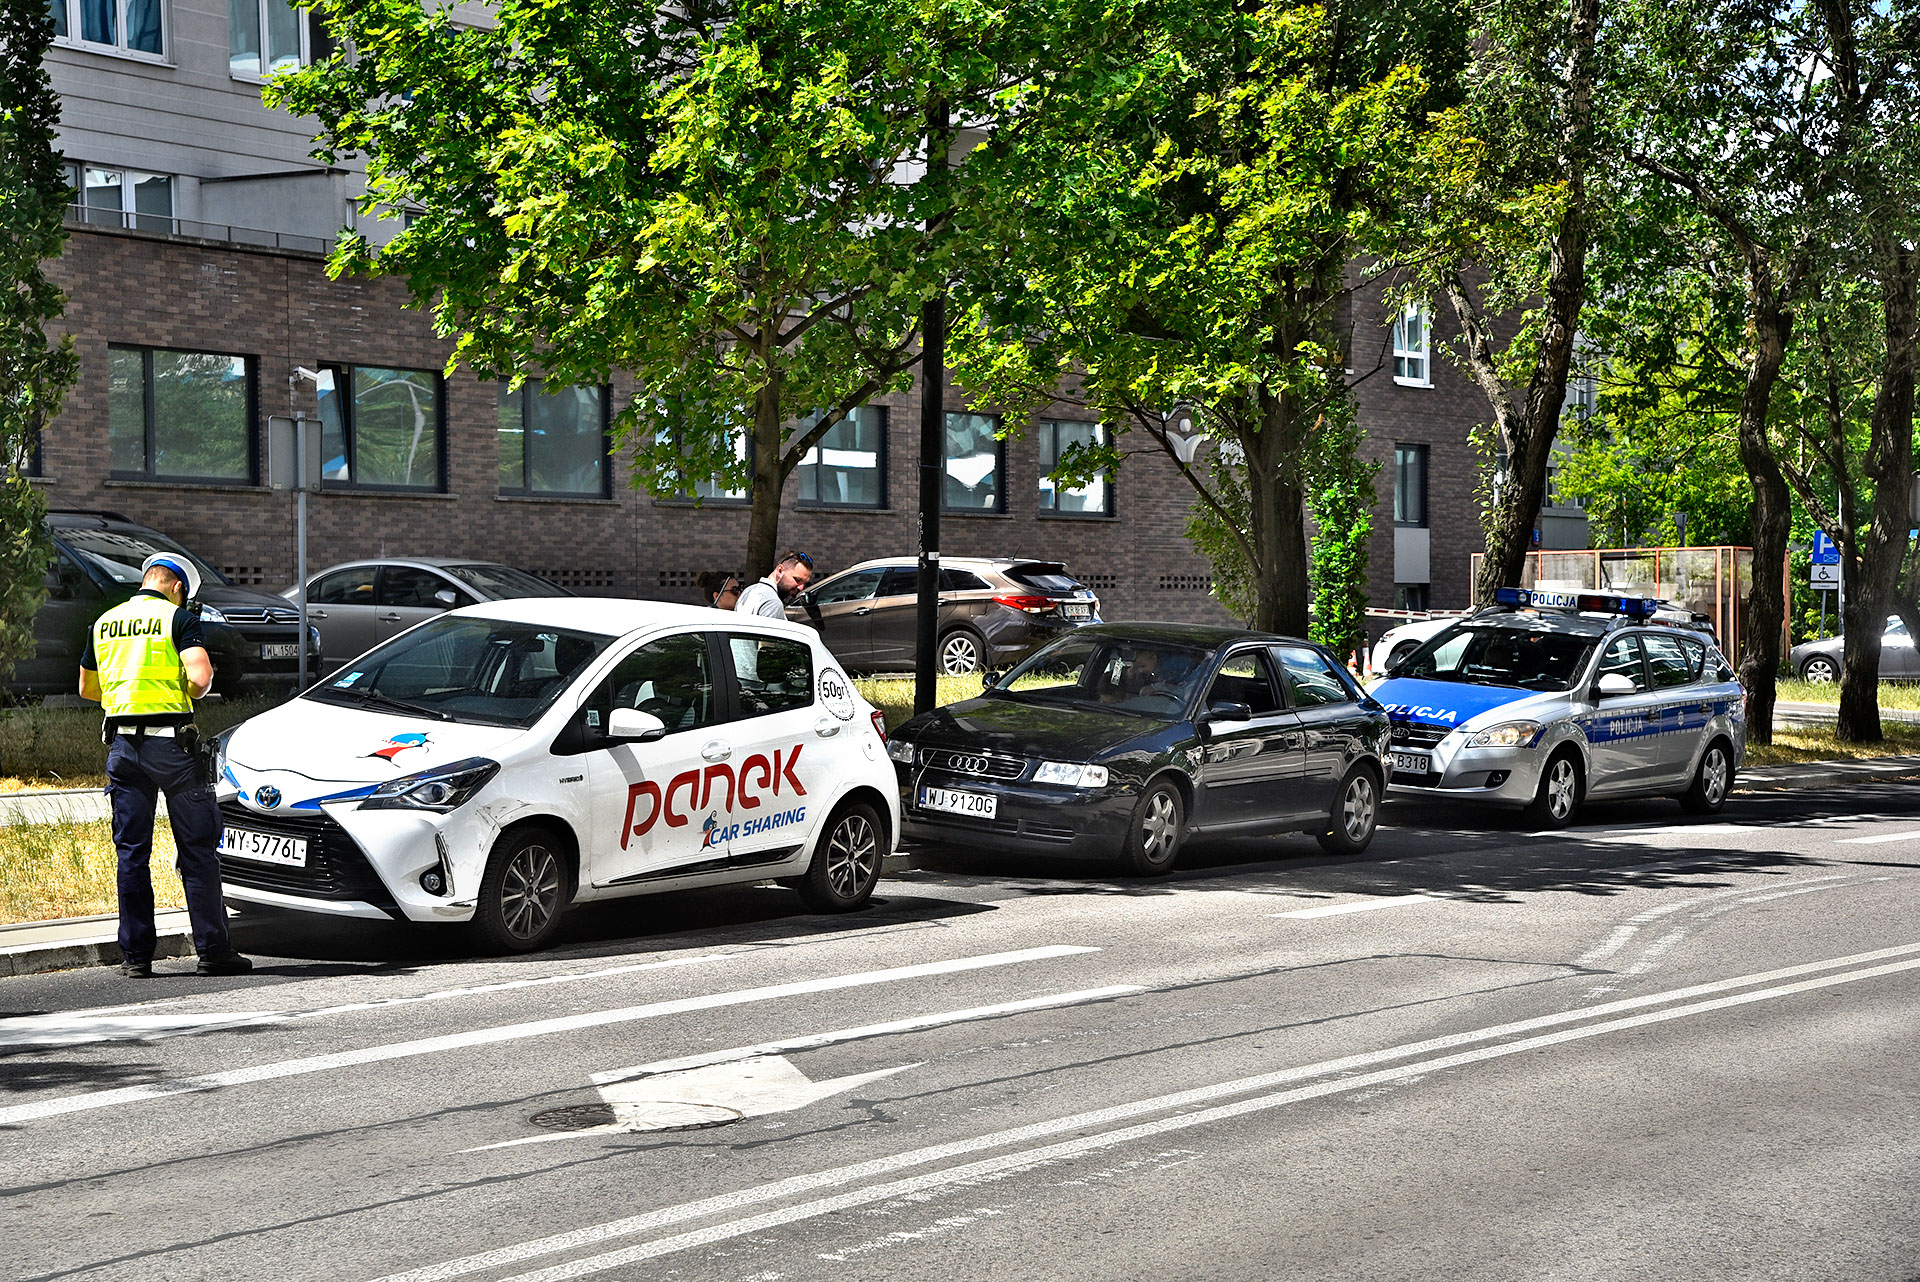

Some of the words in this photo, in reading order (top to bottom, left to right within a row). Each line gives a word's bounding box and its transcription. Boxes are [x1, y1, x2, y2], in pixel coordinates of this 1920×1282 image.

[1820, 533, 1835, 554] P
[1532, 593, 1577, 608] POLICJA
[100, 618, 162, 640] POLICJA
[266, 645, 278, 656] WL
[280, 645, 298, 656] 1504
[822, 681, 845, 700] 50gr
[1380, 703, 1457, 722] OLICJA
[1609, 716, 1644, 737] POLICJA
[1397, 754, 1427, 770] B318
[928, 788, 945, 806] WJ
[950, 793, 993, 814] 9120G
[710, 824, 740, 845] CAR
[742, 806, 807, 837] SHARING
[227, 829, 246, 851] WY
[252, 833, 302, 861] 5776L
